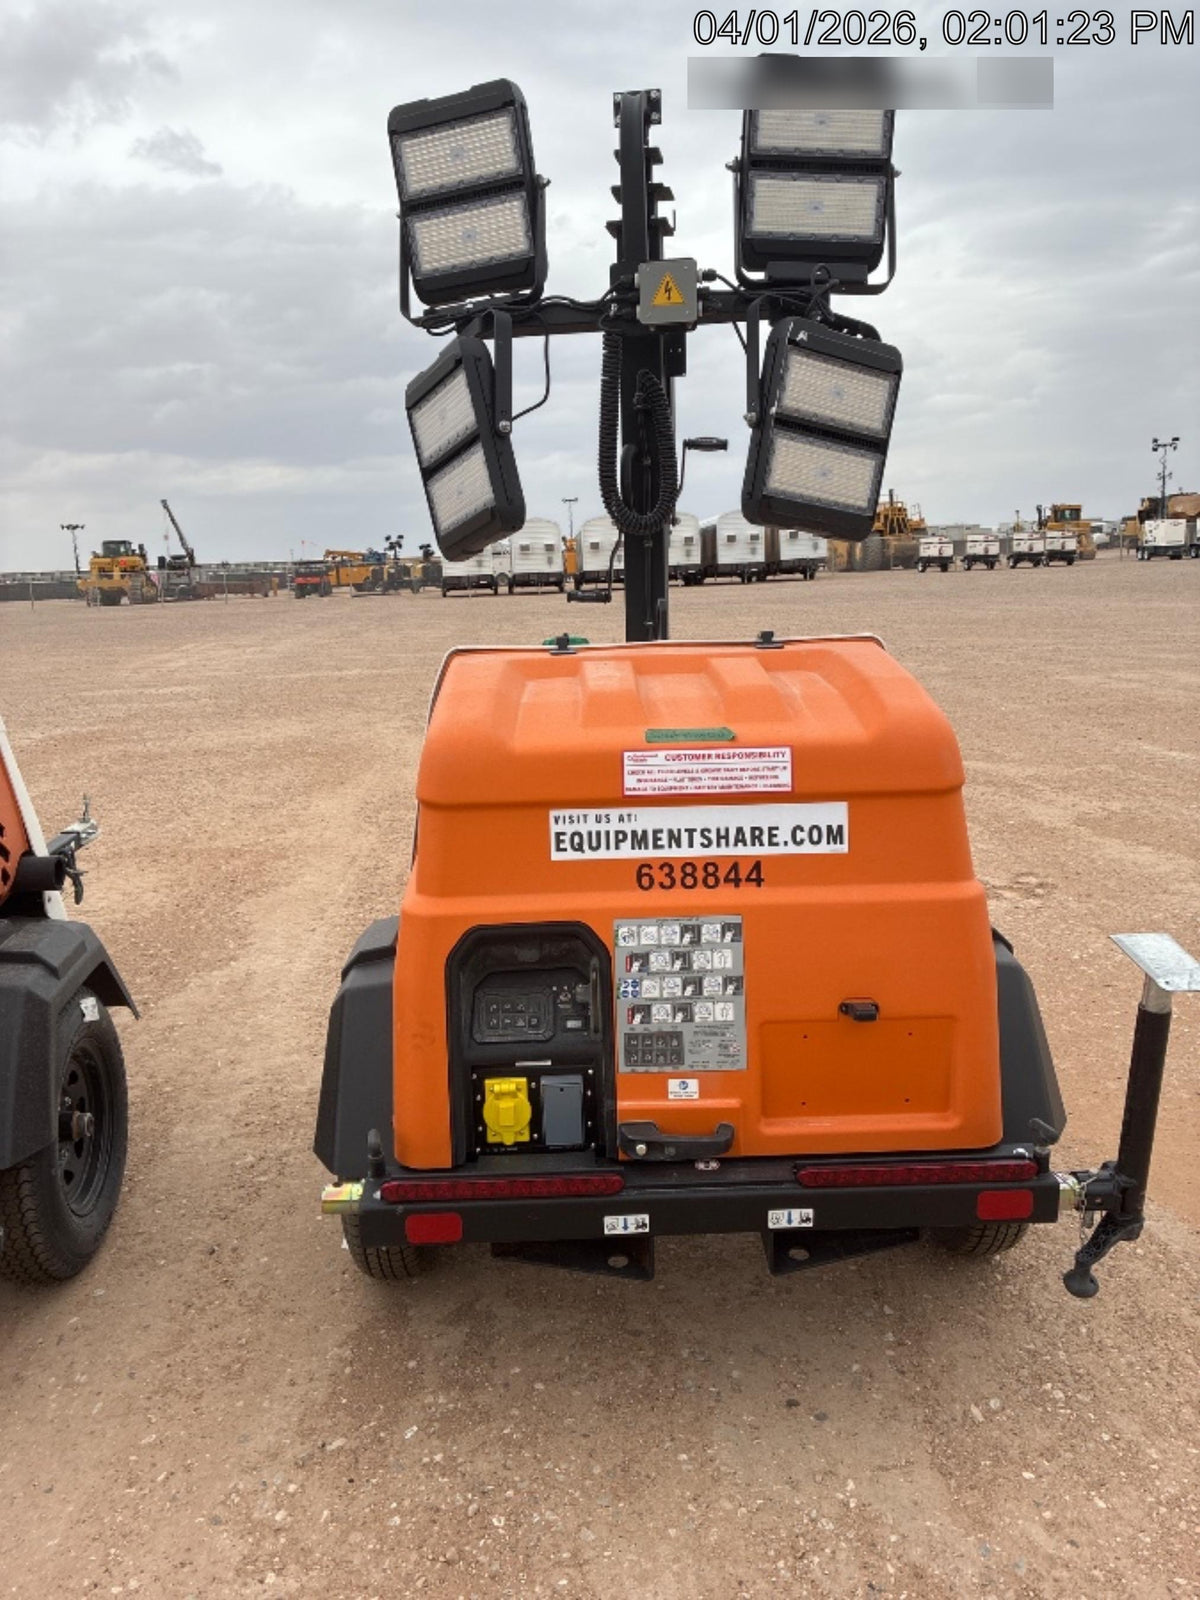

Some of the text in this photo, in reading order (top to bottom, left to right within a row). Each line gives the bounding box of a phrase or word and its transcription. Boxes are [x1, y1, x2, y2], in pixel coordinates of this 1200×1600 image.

[664, 753, 714, 762] CUSTOMER
[714, 750, 787, 760] RESPONSIBILITY
[553, 813, 638, 825] VISIT US AT:
[554, 824, 845, 853] EQUIPMENTSHARE.COM
[636, 860, 765, 891] 638844
